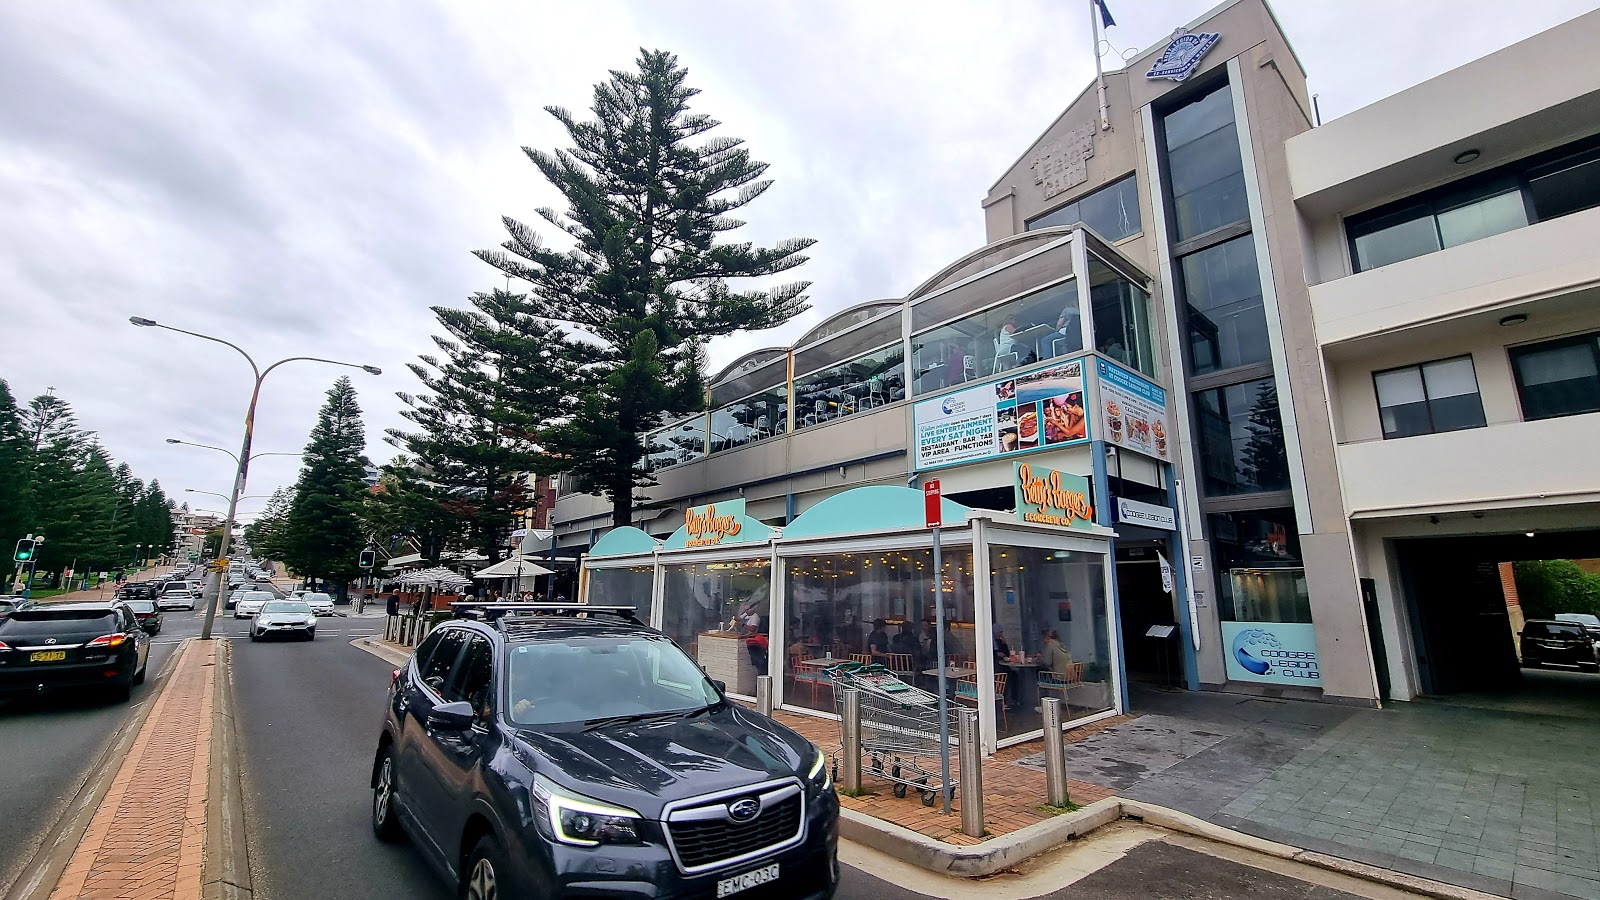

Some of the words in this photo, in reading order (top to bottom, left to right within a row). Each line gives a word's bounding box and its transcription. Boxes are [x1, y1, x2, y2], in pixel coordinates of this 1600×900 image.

[921, 430, 934, 438] LIVE
[936, 418, 992, 434] ENTERTAINMENT
[921, 435, 947, 446] EVERY
[948, 430, 964, 440] SAT
[966, 424, 993, 436] NIGHT
[921, 440, 958, 452] RESTAURANT
[932, 448, 950, 456] AREA
[954, 439, 993, 452] FUNCTIONS
[1020, 463, 1053, 513] Betty's
[1050, 470, 1092, 520] Burgers
[1030, 513, 1061, 525] CONCRETE
[1061, 518, 1072, 526] CO.
[1126, 510, 1145, 519] COOGEE
[686, 508, 706, 539] Betty's
[706, 504, 741, 539] Burgers
[1261, 649, 1316, 660] COOGEE
[1270, 660, 1318, 669] LEGION
[1282, 669, 1320, 679] CLUB
